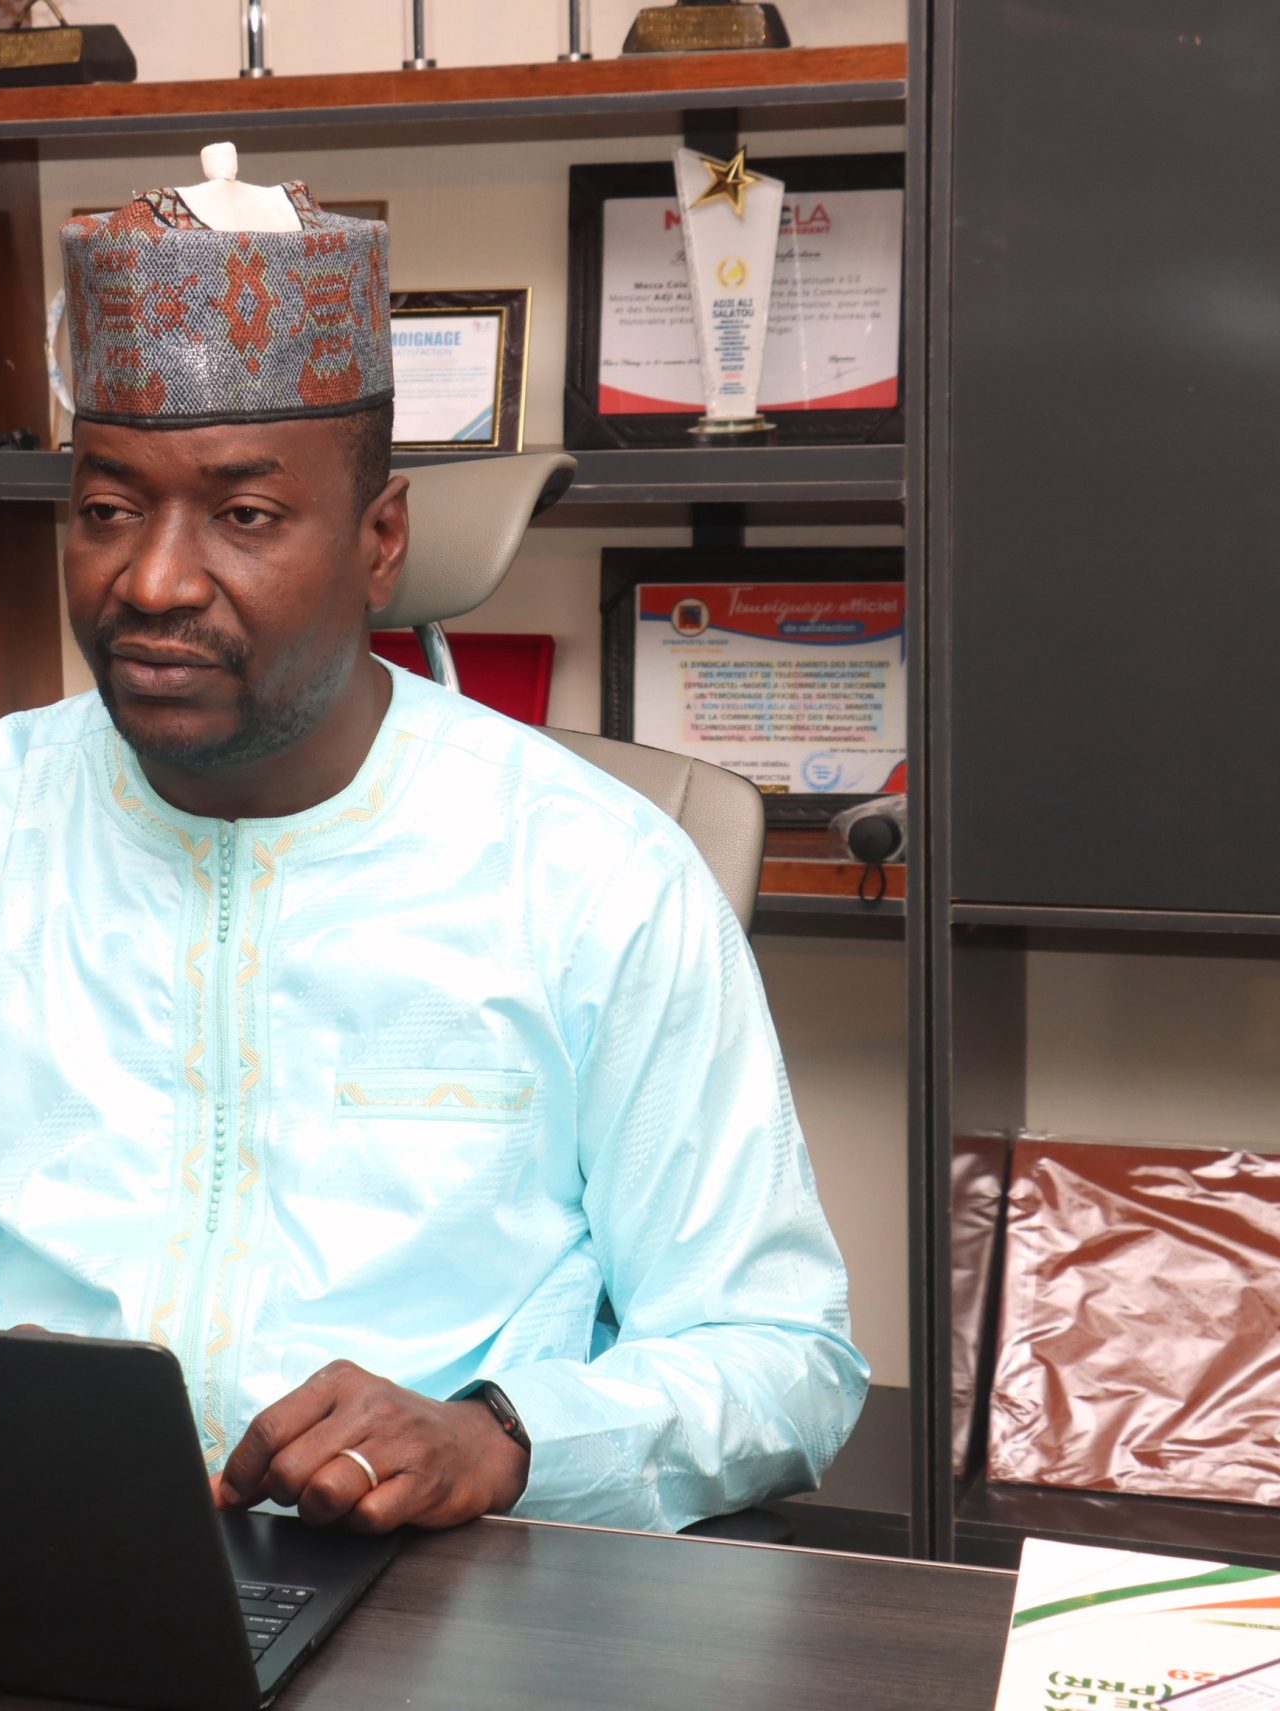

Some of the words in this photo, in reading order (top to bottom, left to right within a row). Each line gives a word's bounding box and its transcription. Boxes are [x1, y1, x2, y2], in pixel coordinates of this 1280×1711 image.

[713, 298, 735, 308] ADJI
[737, 298, 753, 308] ALI
[712, 308, 755, 319] SALATOU
[1167, 1669, 1230, 1684] 29
[1048, 1671, 1173, 1700] (PRR)
[1044, 1688, 1097, 1705] LA
